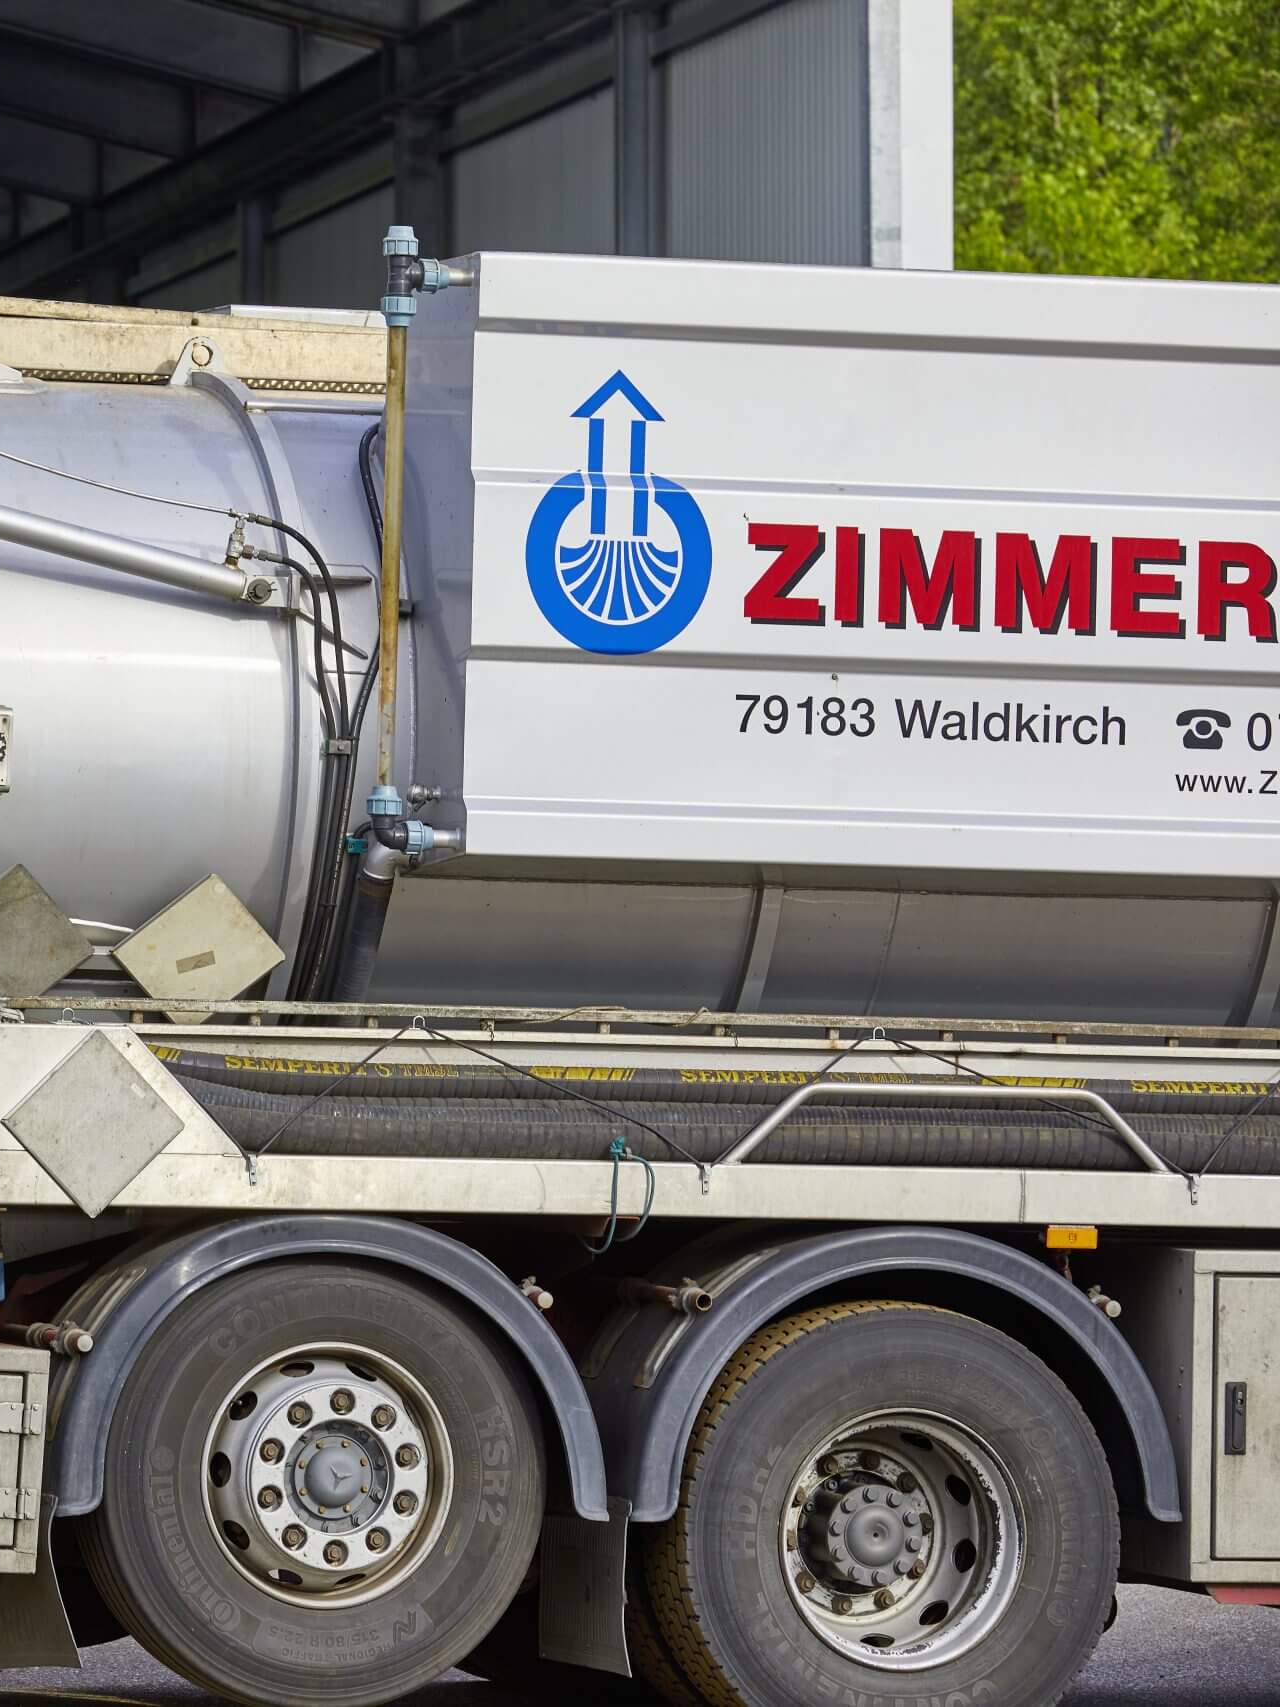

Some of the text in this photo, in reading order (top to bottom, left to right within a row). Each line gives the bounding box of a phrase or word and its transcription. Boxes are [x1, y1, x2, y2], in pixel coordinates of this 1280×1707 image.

[743, 523, 1279, 644] ZIMMER
[735, 694, 1280, 752] 79183 Waldkirch 0
[224, 1054, 368, 1076] SEMPERIT
[1131, 1078, 1269, 1096] SEMPERIT
